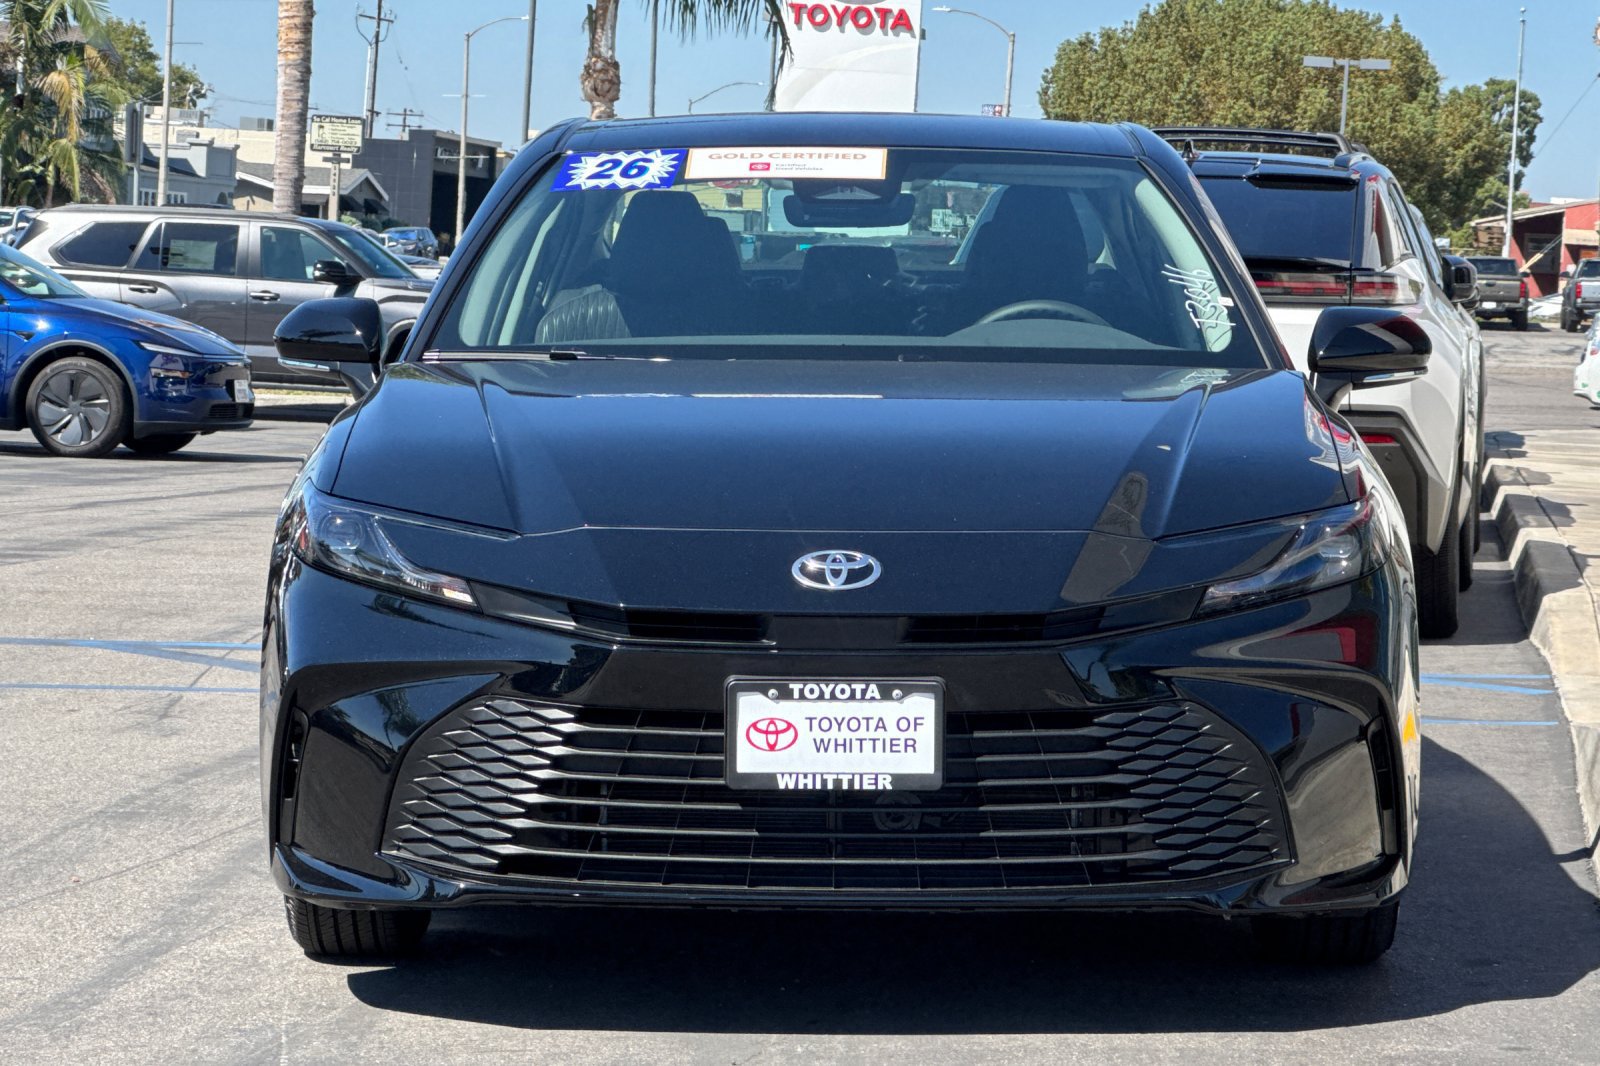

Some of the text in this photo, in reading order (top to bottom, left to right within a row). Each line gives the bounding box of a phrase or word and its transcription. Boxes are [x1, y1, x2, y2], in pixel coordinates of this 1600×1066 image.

[788, 3, 914, 31] TOYOTA
[586, 158, 654, 179] 26
[789, 684, 881, 700] TOYOTA
[805, 716, 925, 732] TOYOTA OF
[813, 738, 918, 753] WHITTIER
[776, 773, 892, 790] WHITTIER
